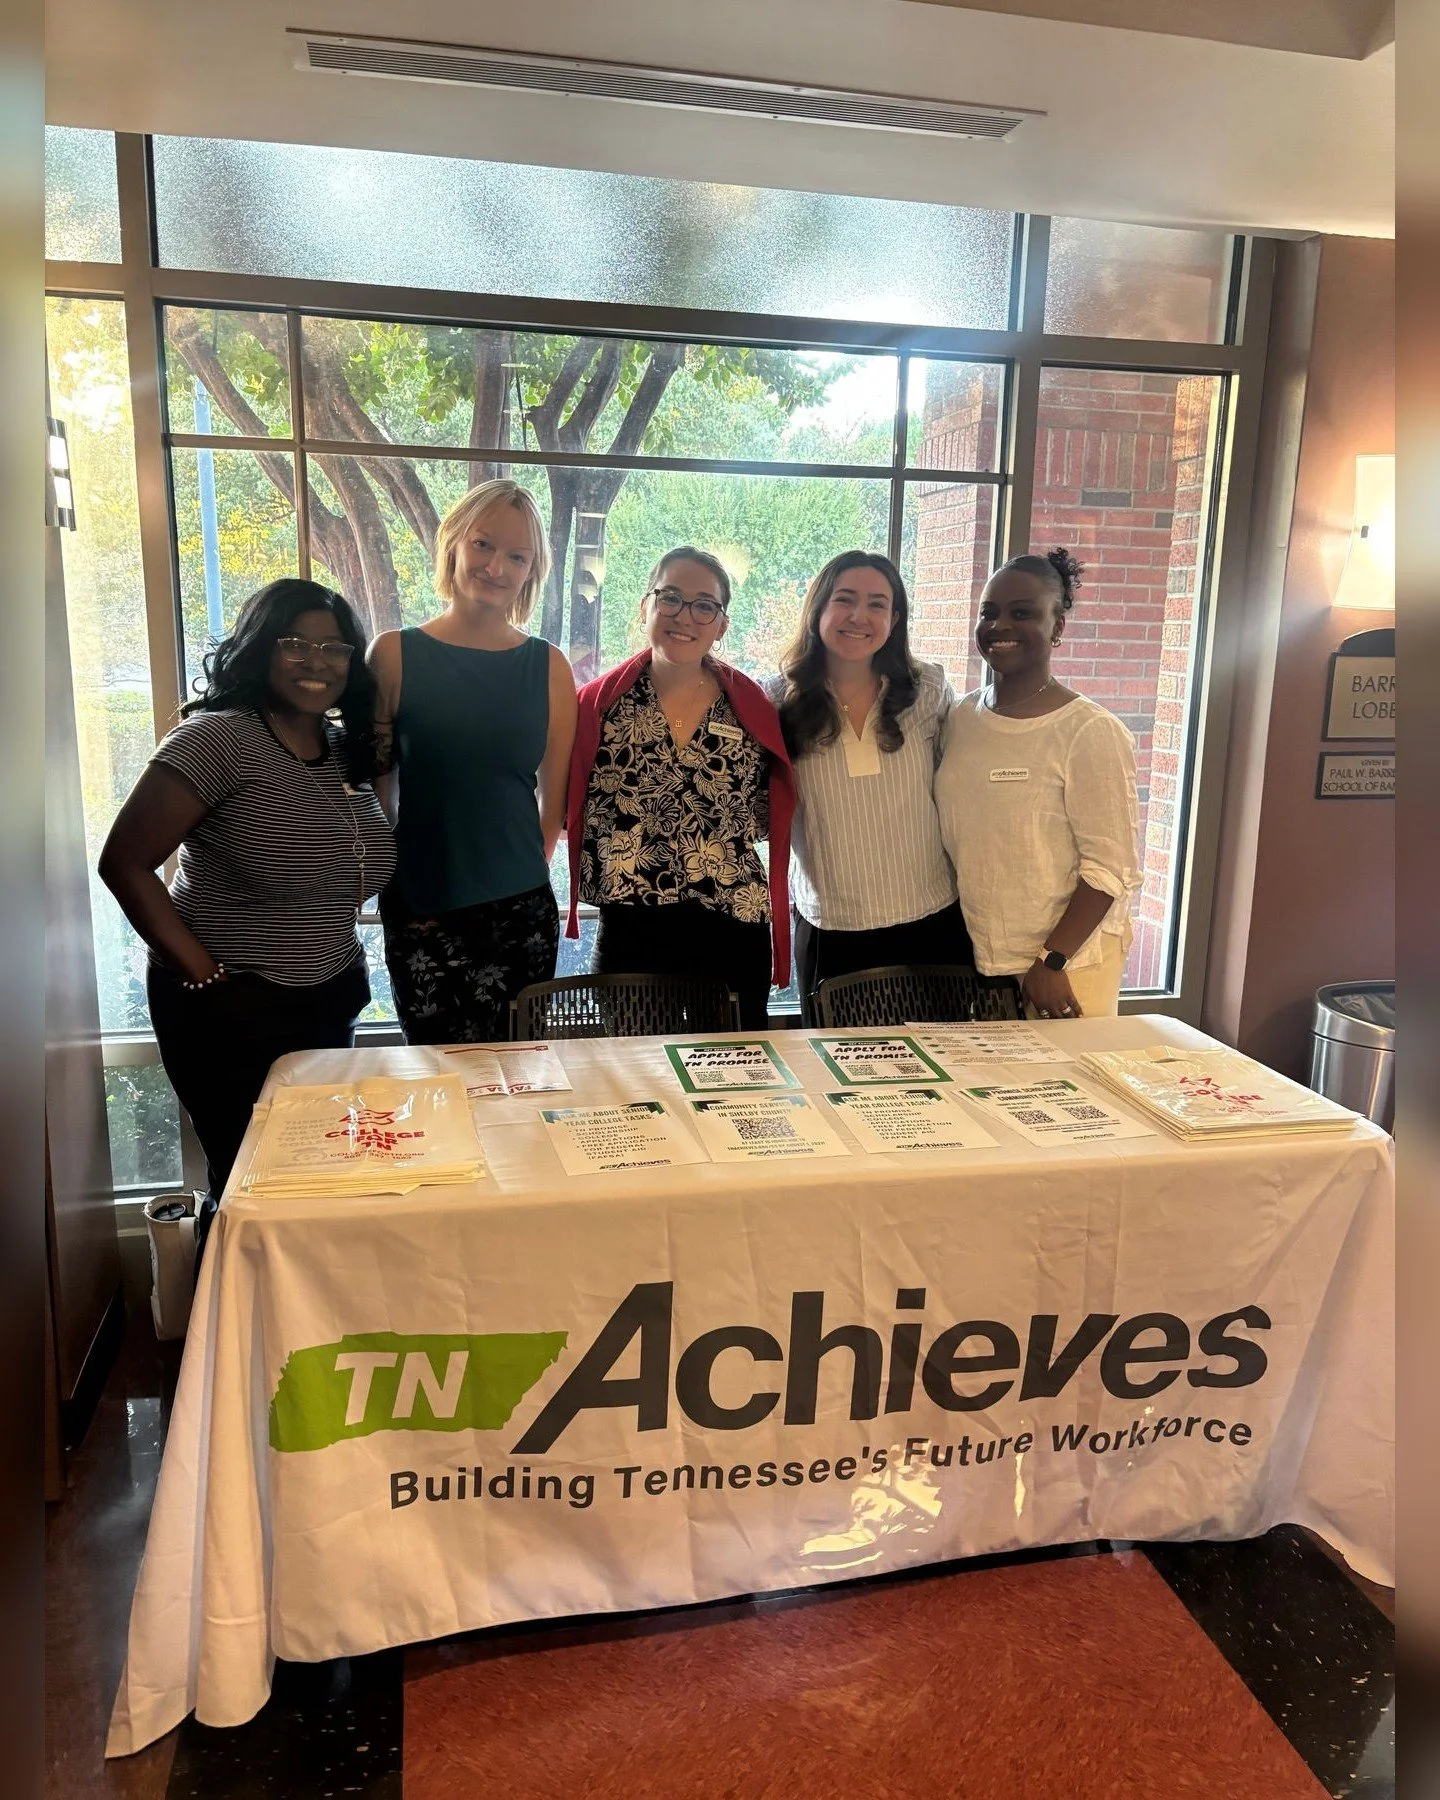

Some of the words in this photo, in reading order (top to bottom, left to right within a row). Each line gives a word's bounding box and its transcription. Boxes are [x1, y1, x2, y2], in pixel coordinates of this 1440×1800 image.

[1330, 768, 1354, 778] PAUL
[1355, 768, 1366, 778] W.
[1323, 782, 1363, 792] SCHOOL
[1364, 782, 1379, 792] OF
[707, 1058, 770, 1067] PROMISE
[730, 1110, 759, 1118] SHELBY
[588, 1116, 624, 1125] COLLEGE
[626, 1114, 655, 1122] TASKS:
[324, 1128, 426, 1139] COLLEGE
[356, 1135, 398, 1145] FOR
[361, 1142, 392, 1151] TN
[616, 1158, 671, 1169] Achieves
[334, 1350, 469, 1426] TN
[509, 1280, 1272, 1454] Achieves
[390, 1465, 595, 1510] Building
[614, 1445, 887, 1499] Tennessee's
[903, 1432, 1033, 1468] Future
[1051, 1415, 1252, 1454] Workforce
